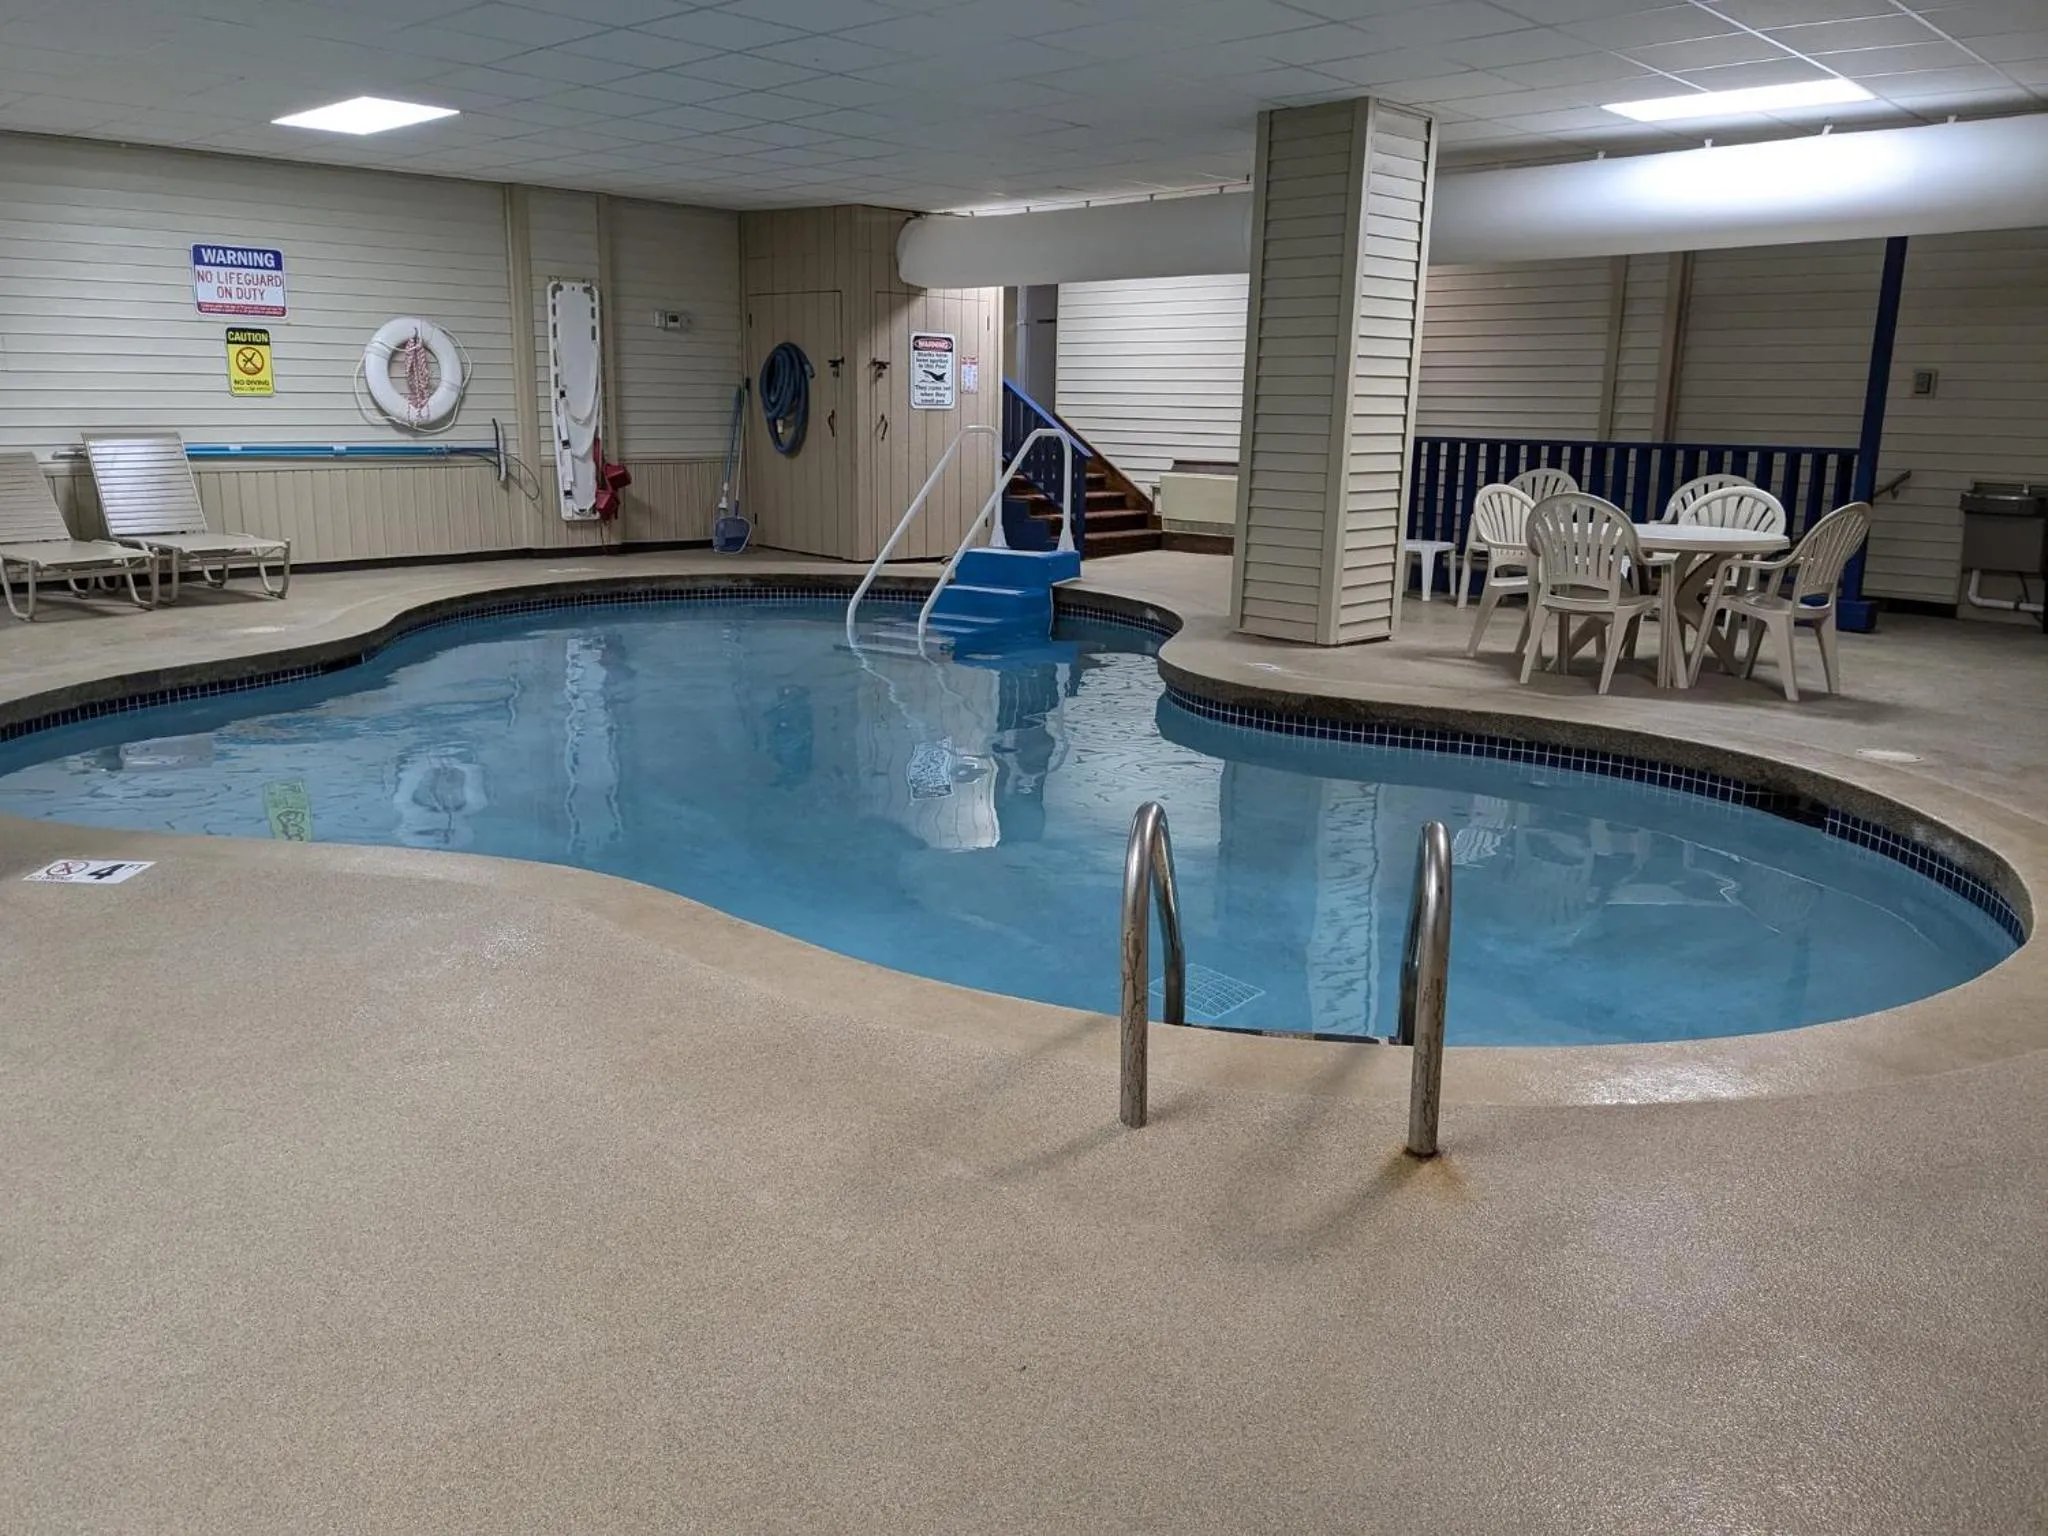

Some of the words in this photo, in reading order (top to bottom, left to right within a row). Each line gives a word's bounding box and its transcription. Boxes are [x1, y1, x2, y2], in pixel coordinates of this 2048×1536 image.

[201, 248, 275, 268] WARNING
[197, 270, 212, 284] NO
[217, 272, 282, 287] LIFEGUARD
[217, 286, 233, 299] ON
[236, 287, 265, 300] DUTY
[228, 331, 268, 343] CAUTION
[87, 863, 126, 880] 4
